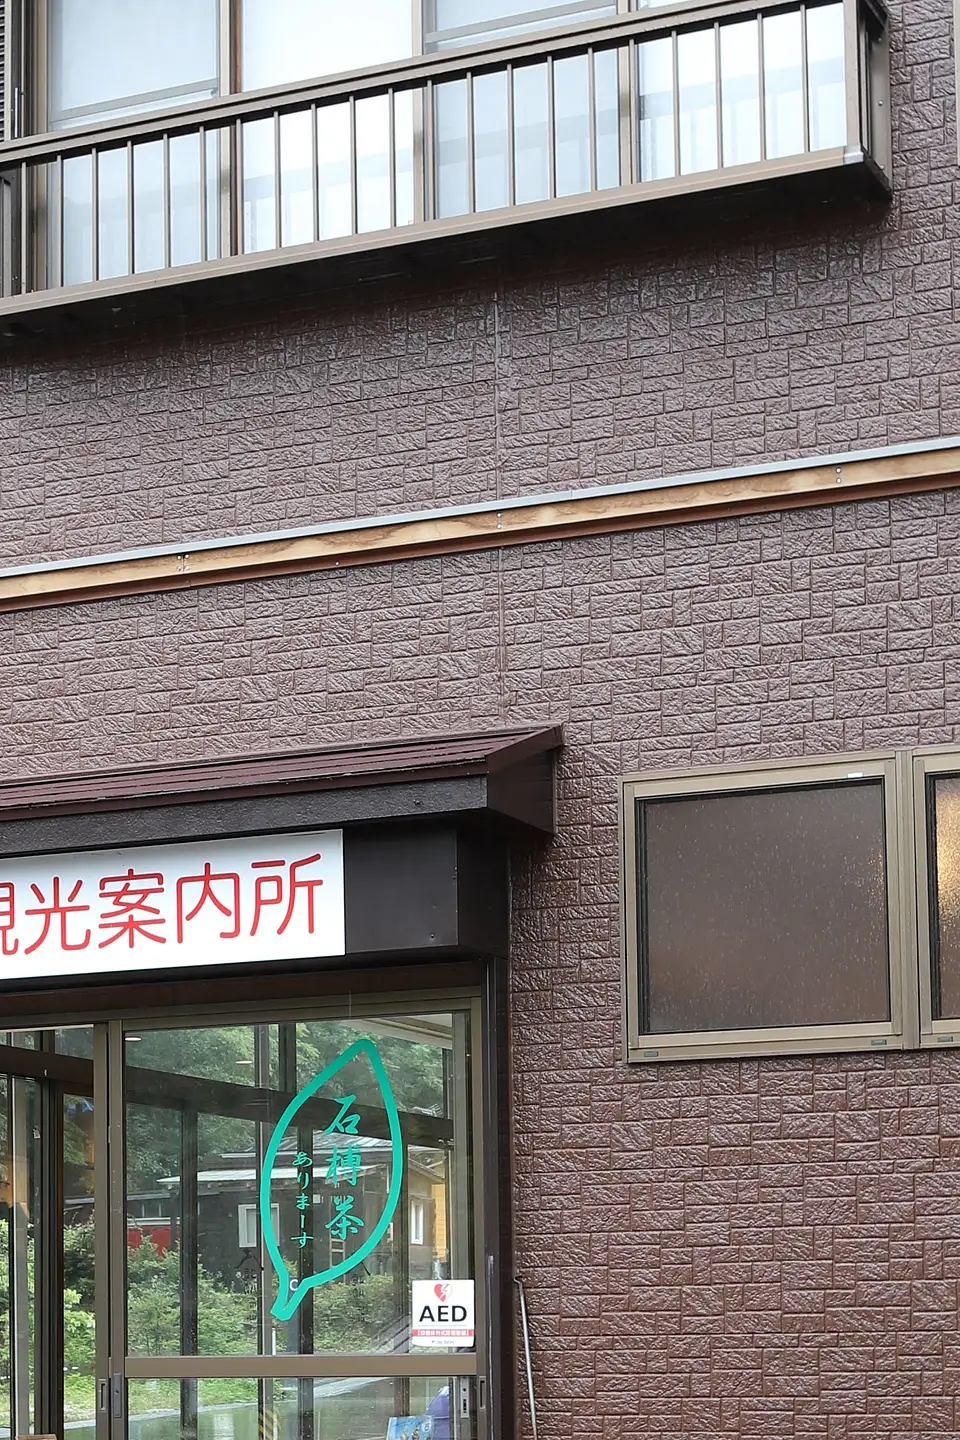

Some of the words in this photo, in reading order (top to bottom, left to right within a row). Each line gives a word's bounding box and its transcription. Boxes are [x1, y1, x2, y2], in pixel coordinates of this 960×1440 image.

[291, 1151, 314, 1249] ありまーす
[419, 1305, 467, 1322] AED
